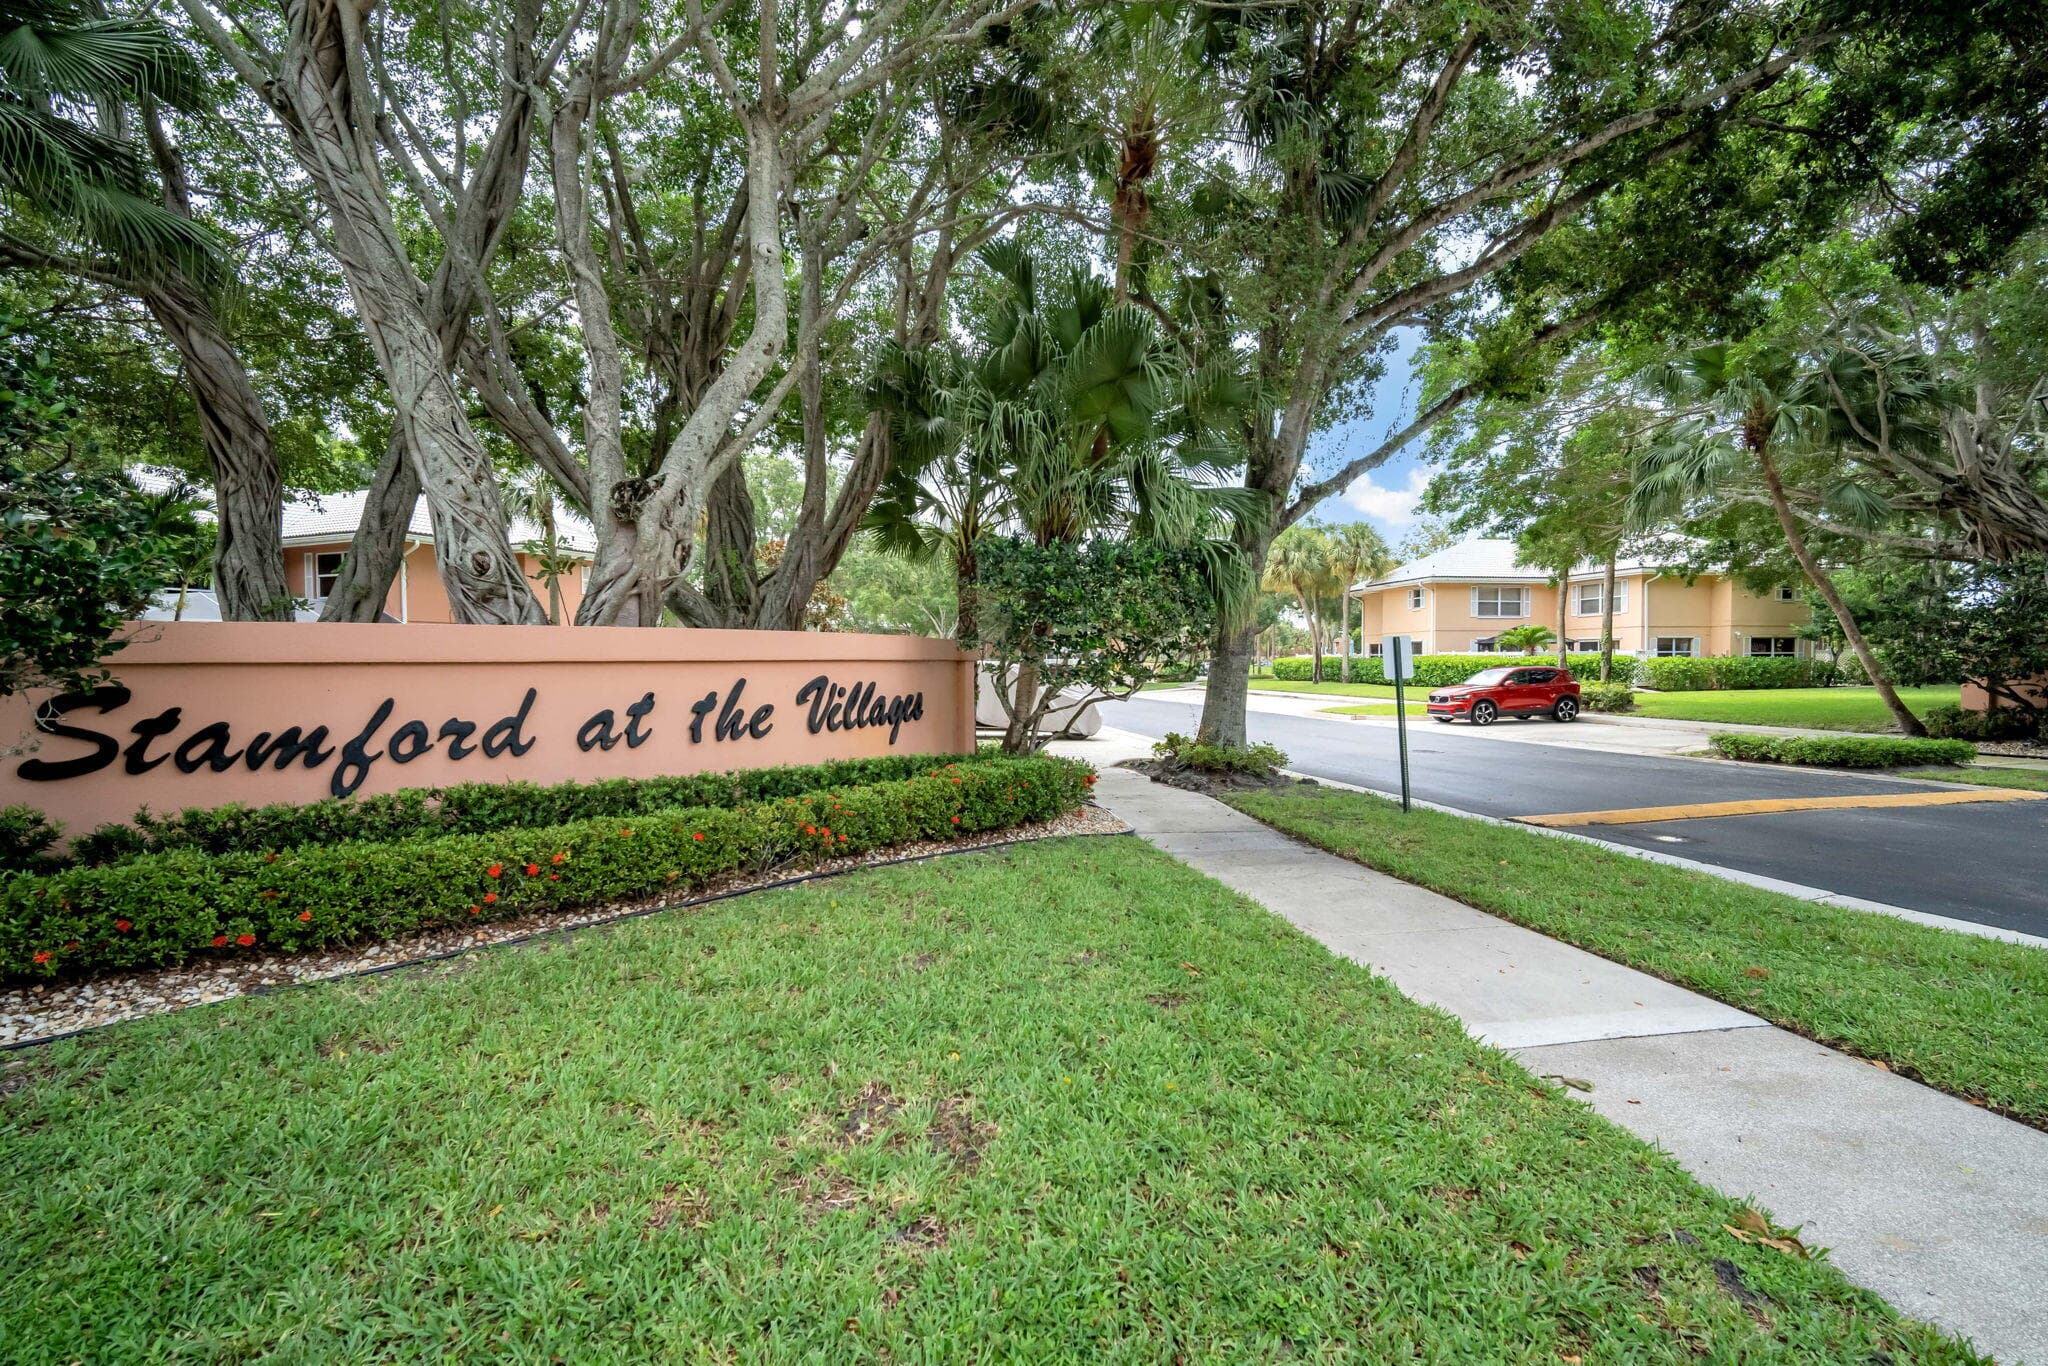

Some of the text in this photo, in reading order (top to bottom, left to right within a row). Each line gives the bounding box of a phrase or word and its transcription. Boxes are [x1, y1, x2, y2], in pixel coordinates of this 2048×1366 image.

[17, 675, 924, 798] Stamford at the Villages
